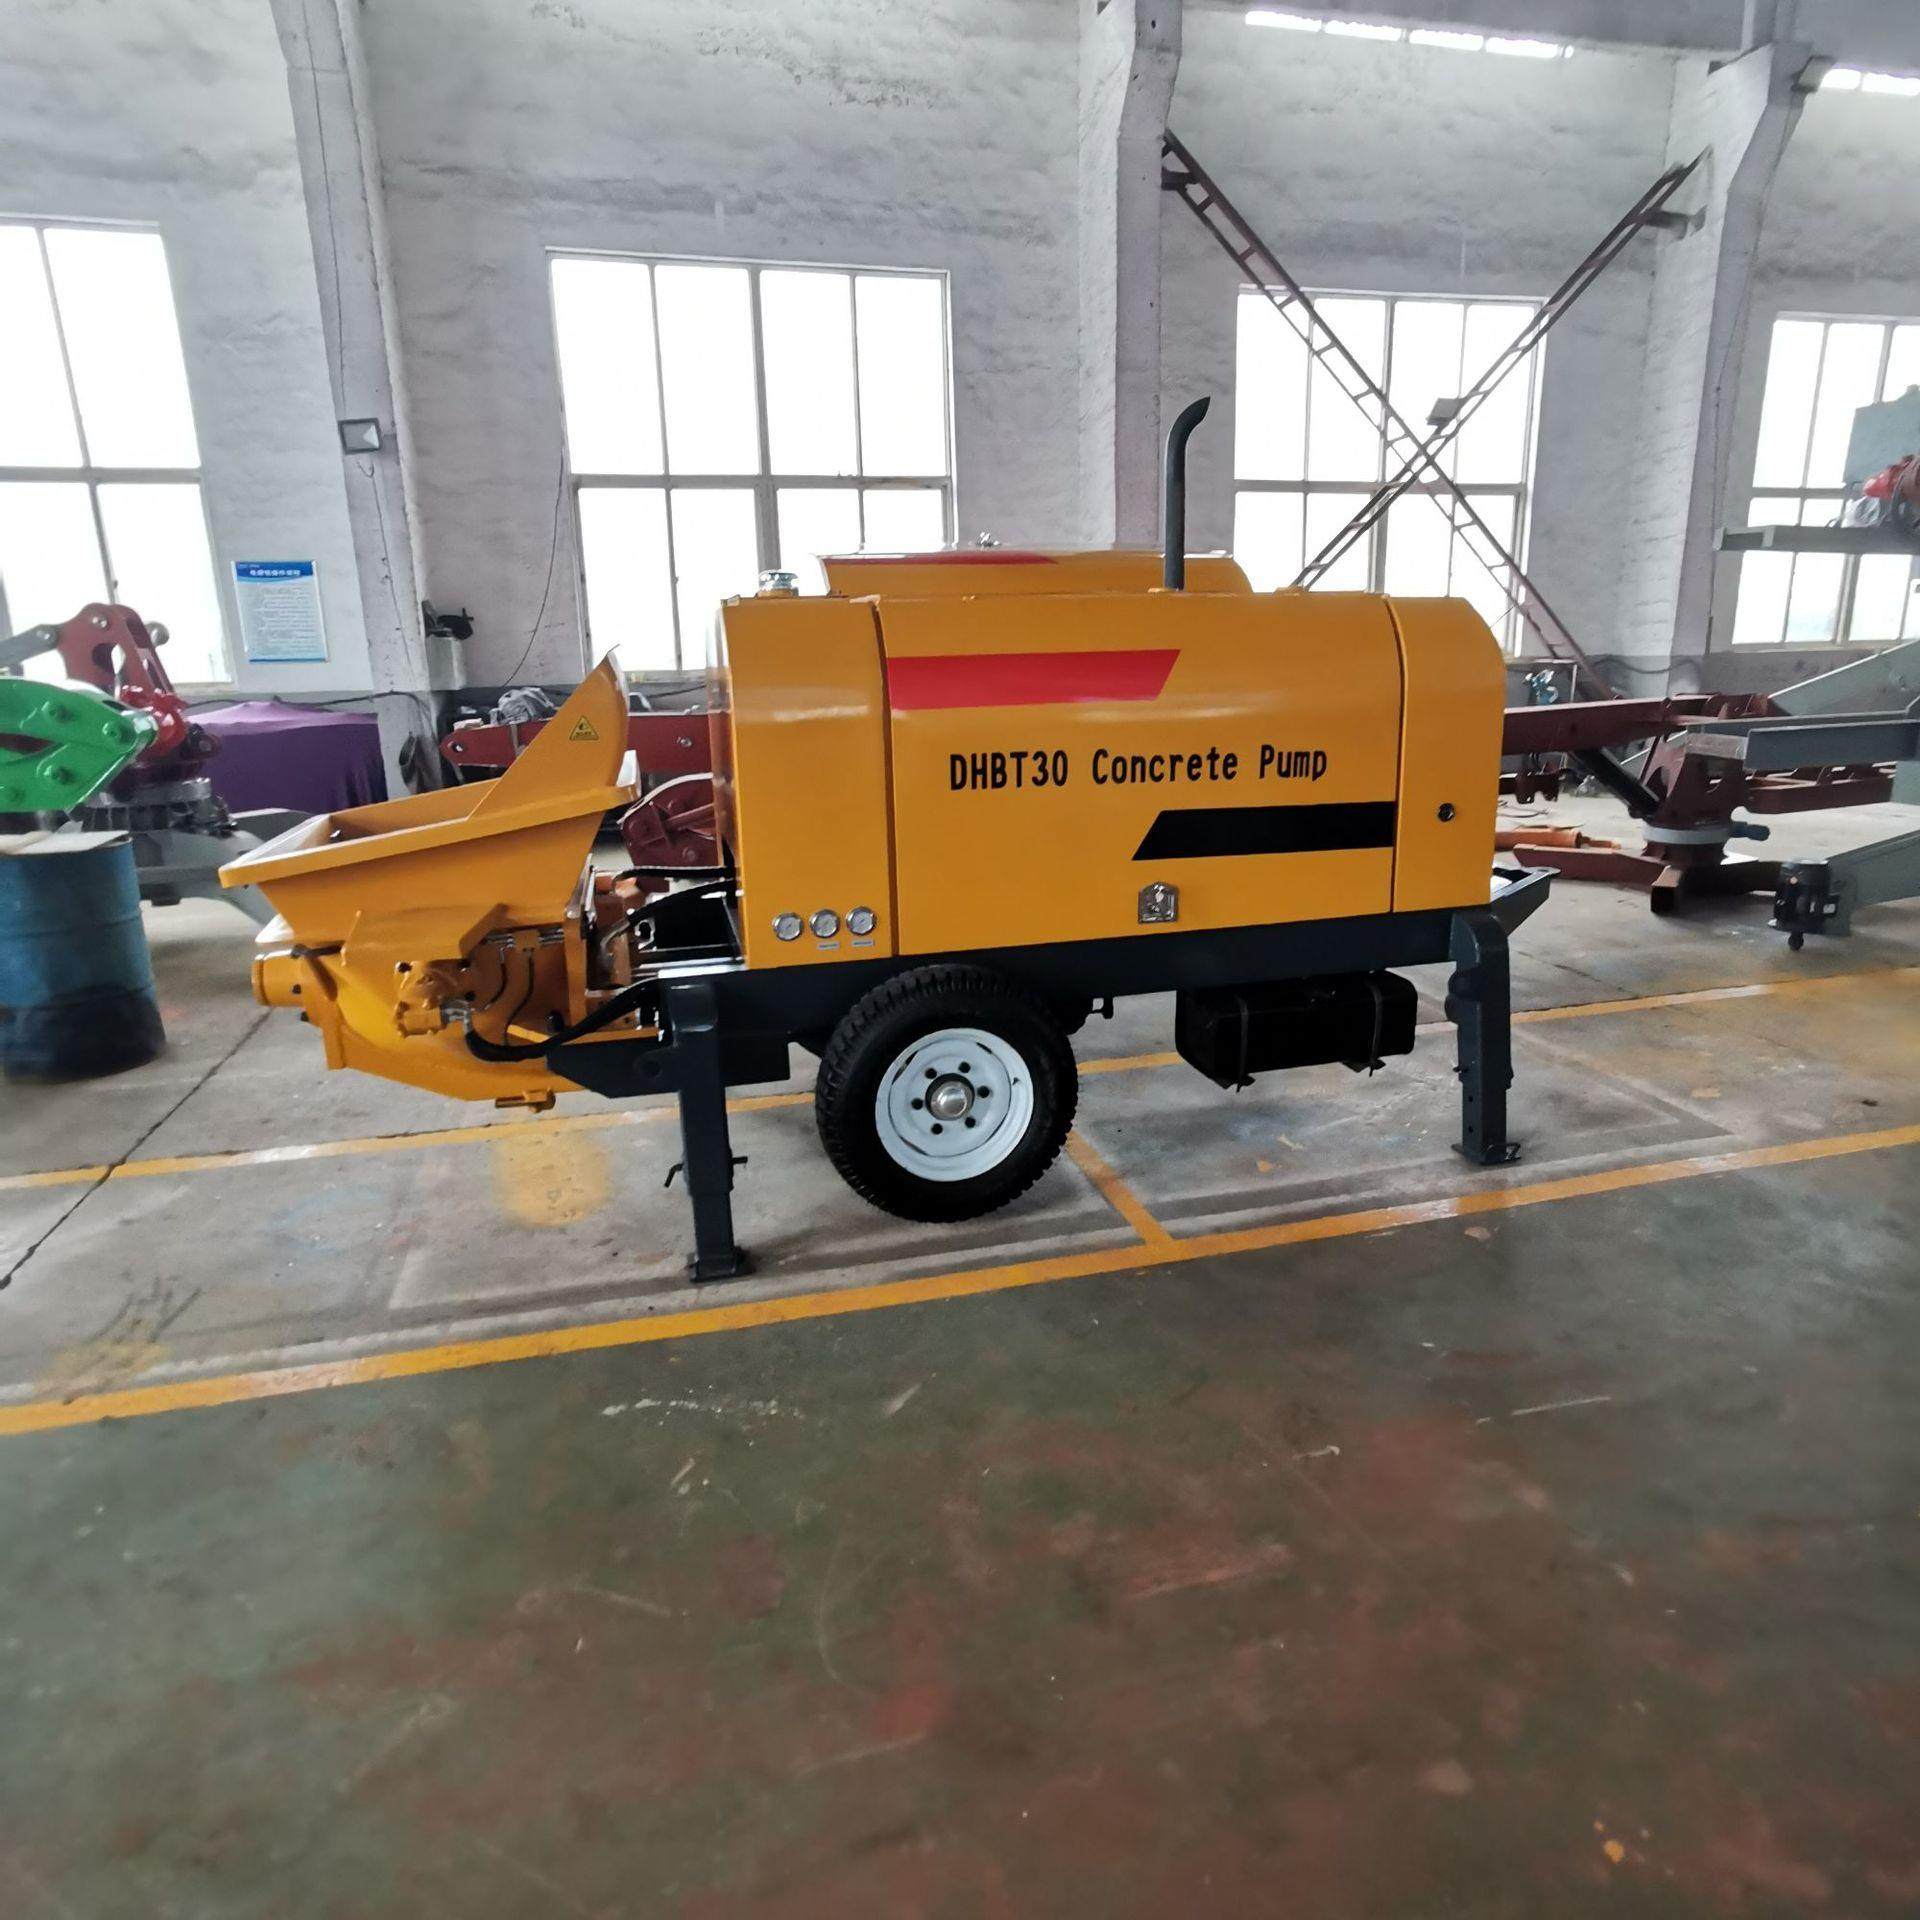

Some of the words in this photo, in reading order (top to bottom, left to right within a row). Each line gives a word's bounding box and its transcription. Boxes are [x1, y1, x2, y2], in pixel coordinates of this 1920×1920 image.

[949, 750, 1069, 790] DHBT30
[1092, 746, 1239, 785] Concrete
[1259, 743, 1328, 782] Pump
